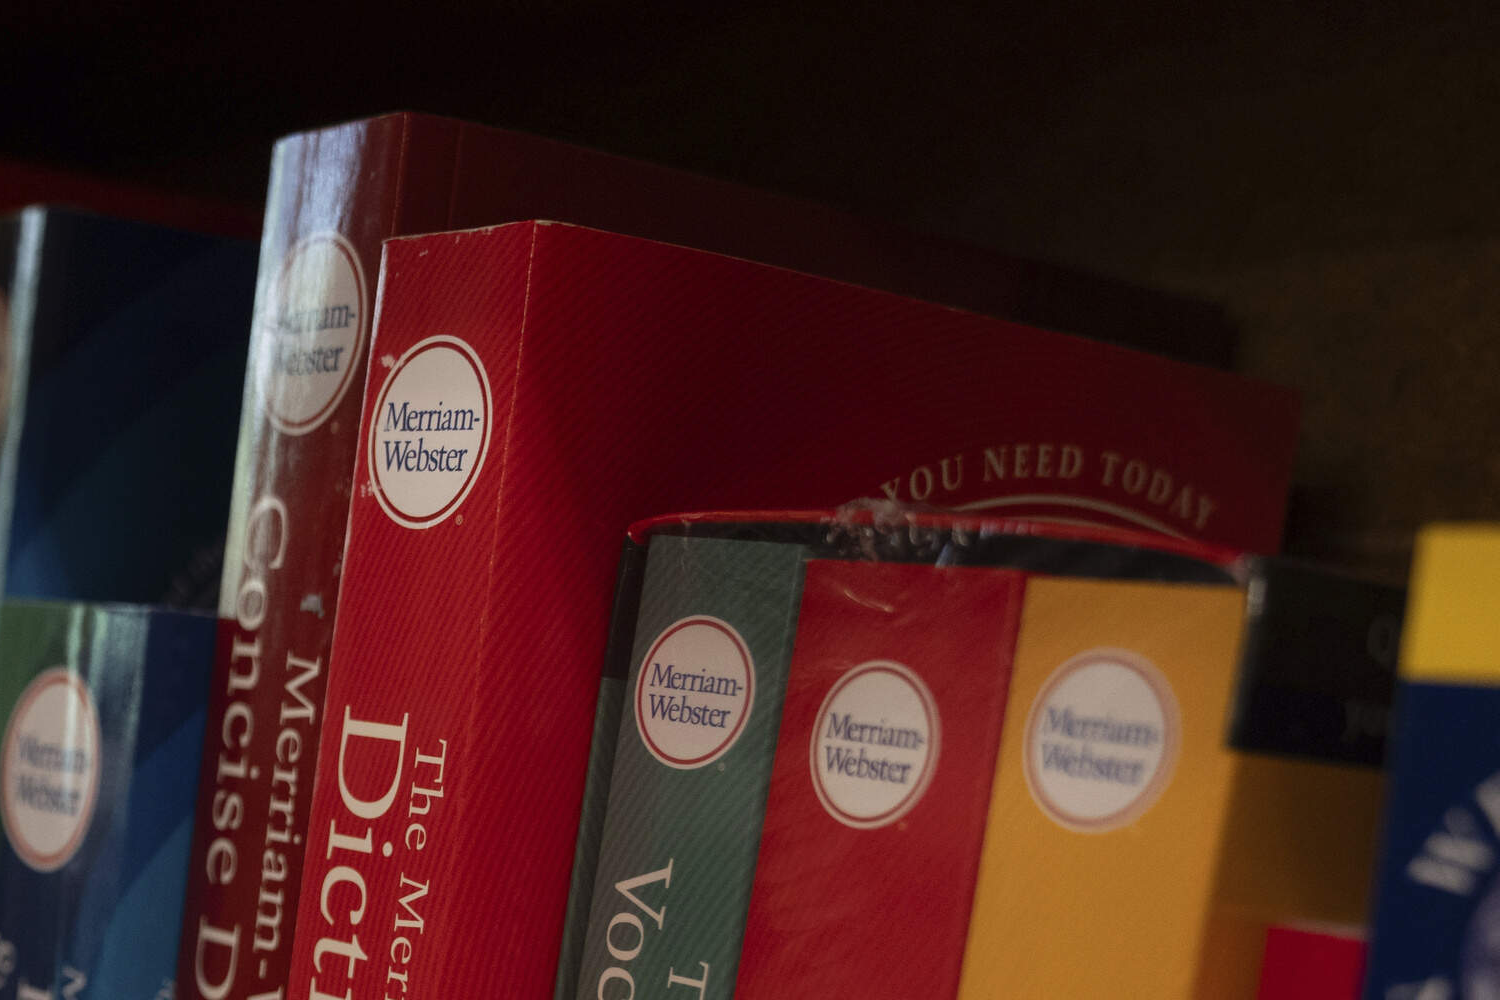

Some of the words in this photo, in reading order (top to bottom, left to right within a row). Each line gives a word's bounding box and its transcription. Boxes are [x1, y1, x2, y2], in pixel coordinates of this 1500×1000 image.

[383, 401, 482, 433] Merriam-
[383, 439, 469, 473] Webster
[881, 454, 965, 506] YOU
[982, 442, 1086, 483] NEED
[1100, 452, 1220, 533] TODAY
[204, 494, 291, 887] Concise
[649, 662, 743, 699] Merriam-
[648, 692, 732, 731] Webster
[825, 710, 926, 751] Merriam-
[824, 745, 913, 787] Webster
[405, 738, 449, 852] The
